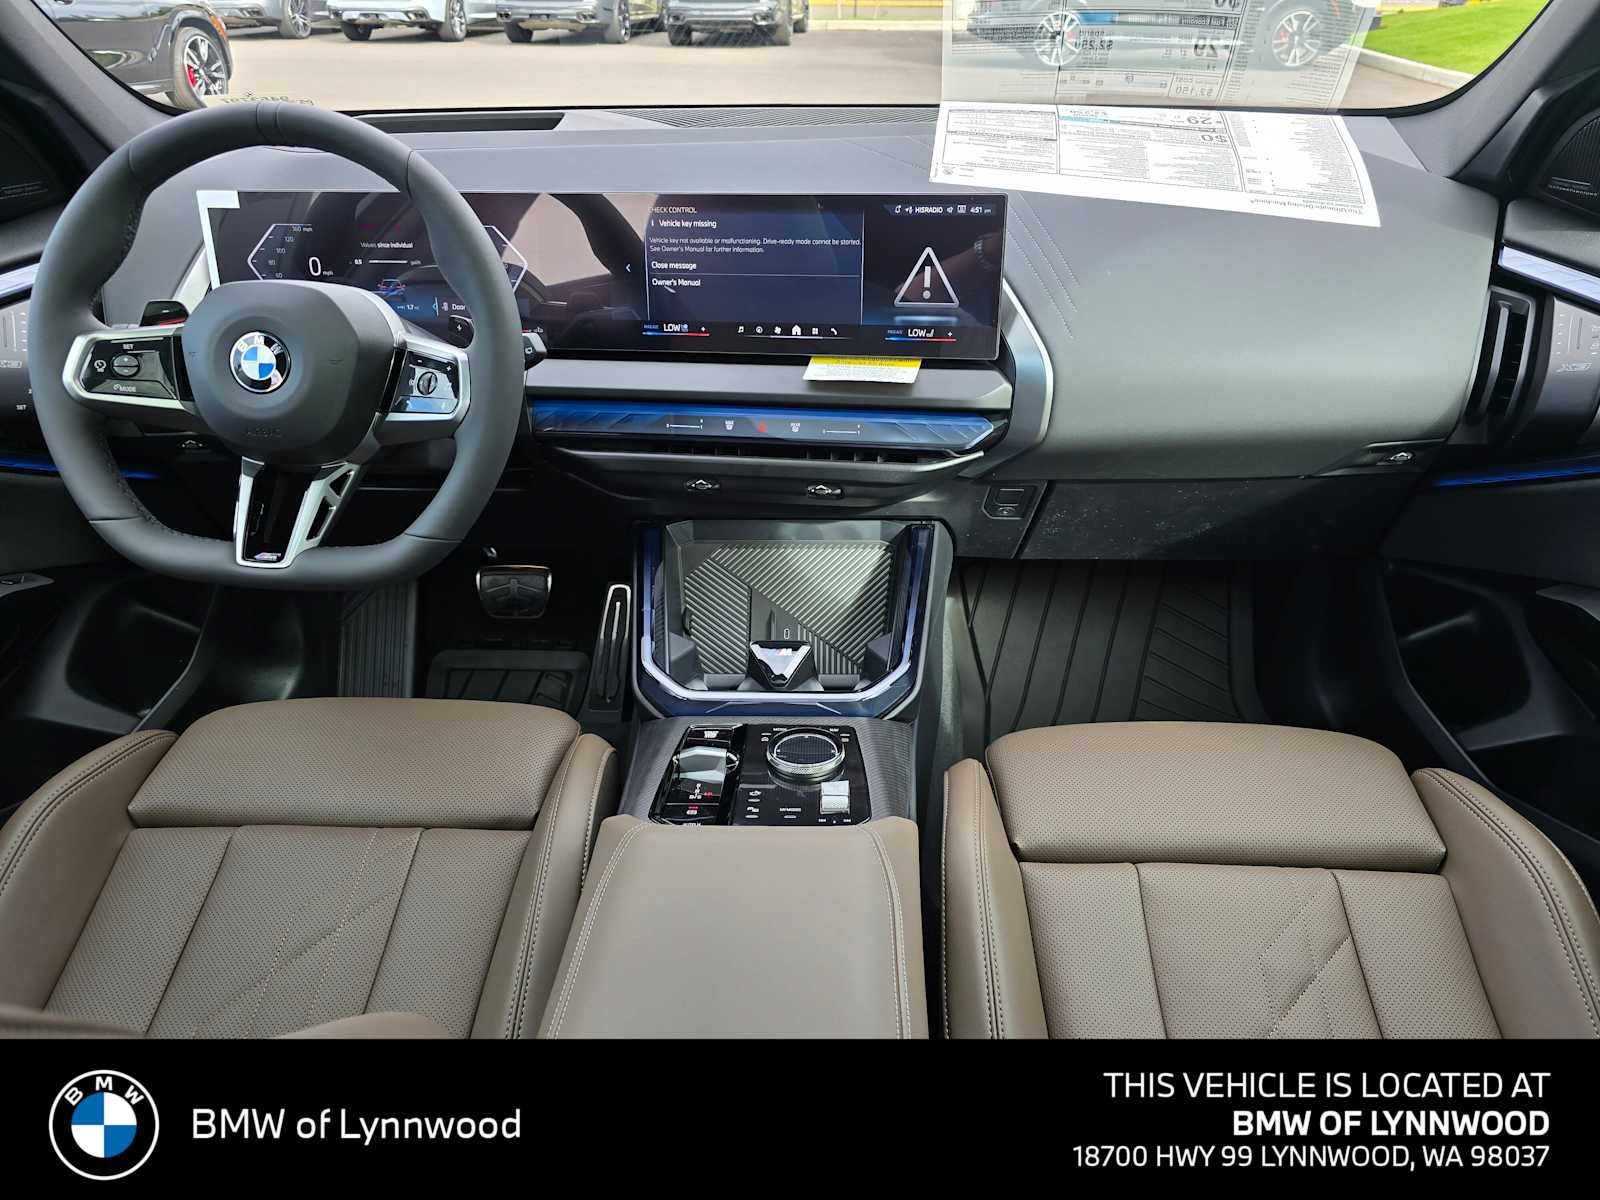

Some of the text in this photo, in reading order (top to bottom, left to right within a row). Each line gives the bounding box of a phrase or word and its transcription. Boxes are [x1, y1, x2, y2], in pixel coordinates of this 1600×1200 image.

[648, 206, 697, 214] CHECK CONTROL
[658, 220, 681, 228] Vehicle
[681, 220, 692, 229] key
[693, 220, 717, 229] missing
[308, 256, 322, 277] 0
[651, 261, 697, 271] Close message
[652, 278, 701, 287] Owner's Manual
[663, 323, 681, 332] LOW
[908, 328, 926, 337] LOW
[119, 385, 137, 393] MODE
